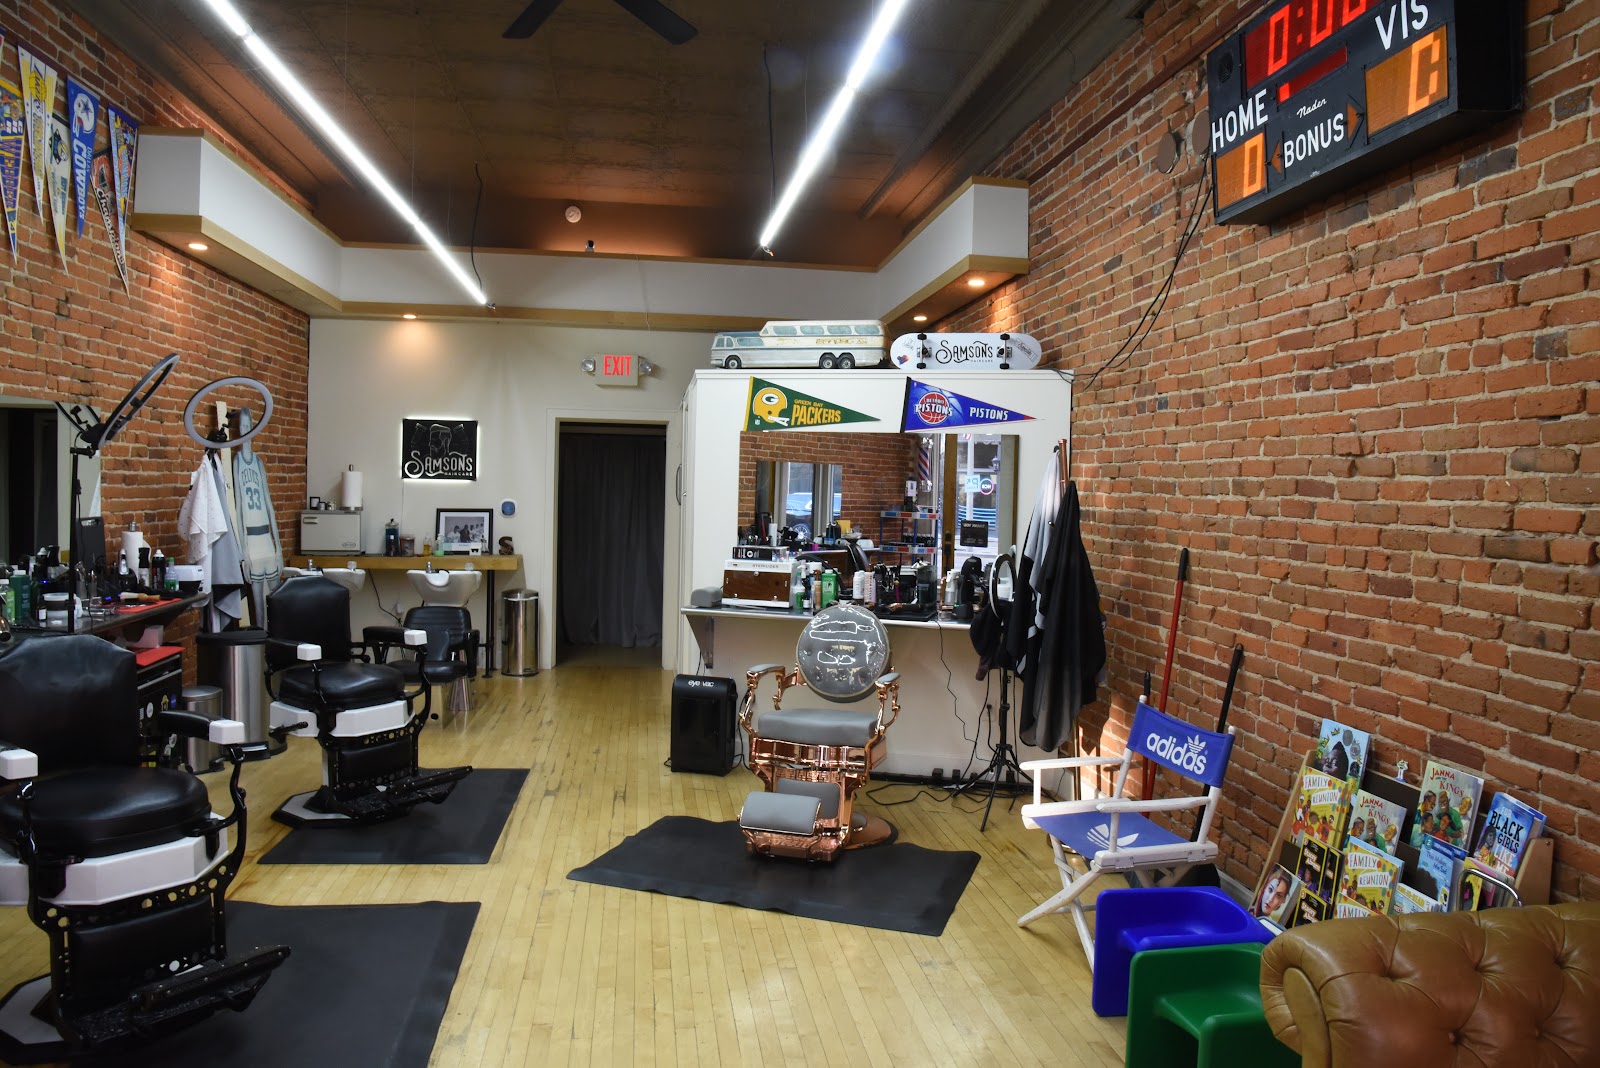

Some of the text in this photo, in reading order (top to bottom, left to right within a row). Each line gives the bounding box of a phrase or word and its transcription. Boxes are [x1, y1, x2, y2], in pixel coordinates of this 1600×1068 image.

[1375, 0, 1429, 50] VIS
[1296, 98, 1327, 118] Naden
[1211, 88, 1269, 152] HOME
[1284, 112, 1345, 168] BONUS
[73, 138, 87, 219] COWBOYS
[603, 355, 632, 376] EXIT
[791, 404, 841, 426] PACKERS
[914, 403, 953, 417] PISTONS
[969, 406, 1009, 421] PISTONS
[245, 486, 262, 511] 33
[1146, 732, 1207, 775] adidas
[1304, 776, 1328, 789] FAMILY
[1430, 767, 1456, 780] JANNA
[1312, 790, 1339, 804] REUNION
[1439, 780, 1465, 797] KINGS
[1360, 796, 1383, 809] JANNA
[1368, 808, 1391, 825] KINGS
[1489, 810, 1524, 842] BLACK
[1497, 833, 1519, 854] GIRLS
[1349, 853, 1377, 868] FAMILY
[1360, 873, 1389, 887] REUNION
